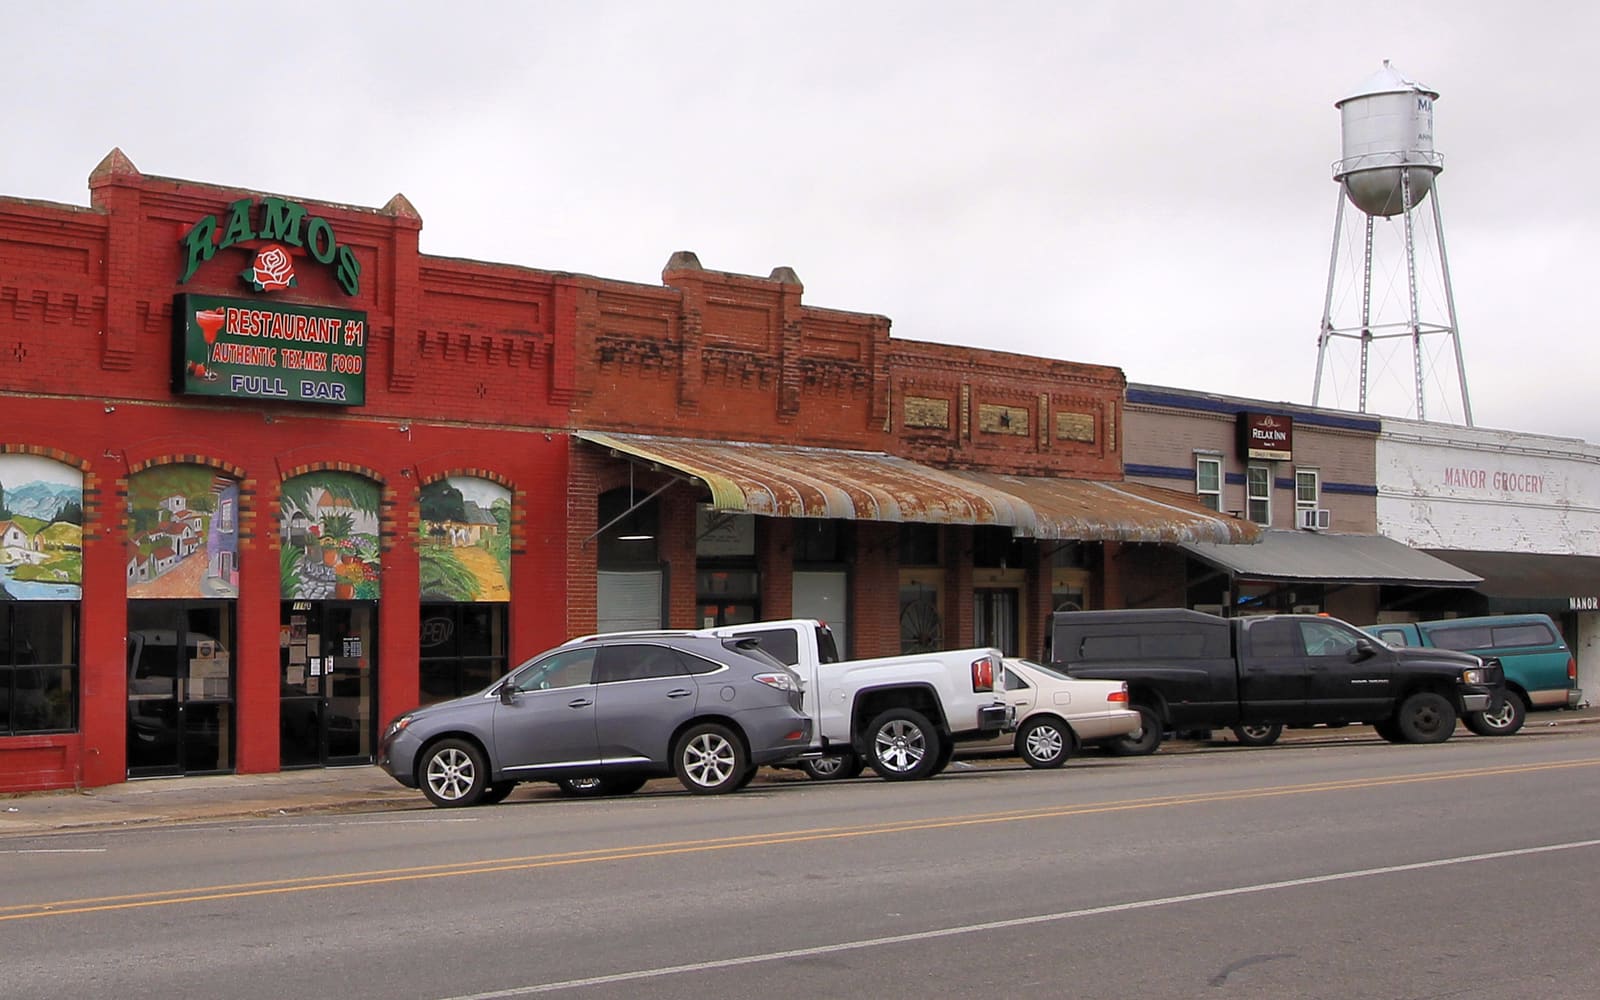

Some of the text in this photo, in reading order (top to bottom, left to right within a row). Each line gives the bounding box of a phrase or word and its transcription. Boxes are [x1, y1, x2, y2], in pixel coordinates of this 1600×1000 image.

[178, 198, 361, 296] RAMOS
[226, 308, 363, 346] RESTAURANT #1
[212, 343, 362, 374] AUTHENTIC TEX-MEX FOOD
[231, 374, 346, 400] FULL BAR
[1445, 467, 1544, 494] MANOR GROCERY
[1569, 596, 1599, 610] MANOR
